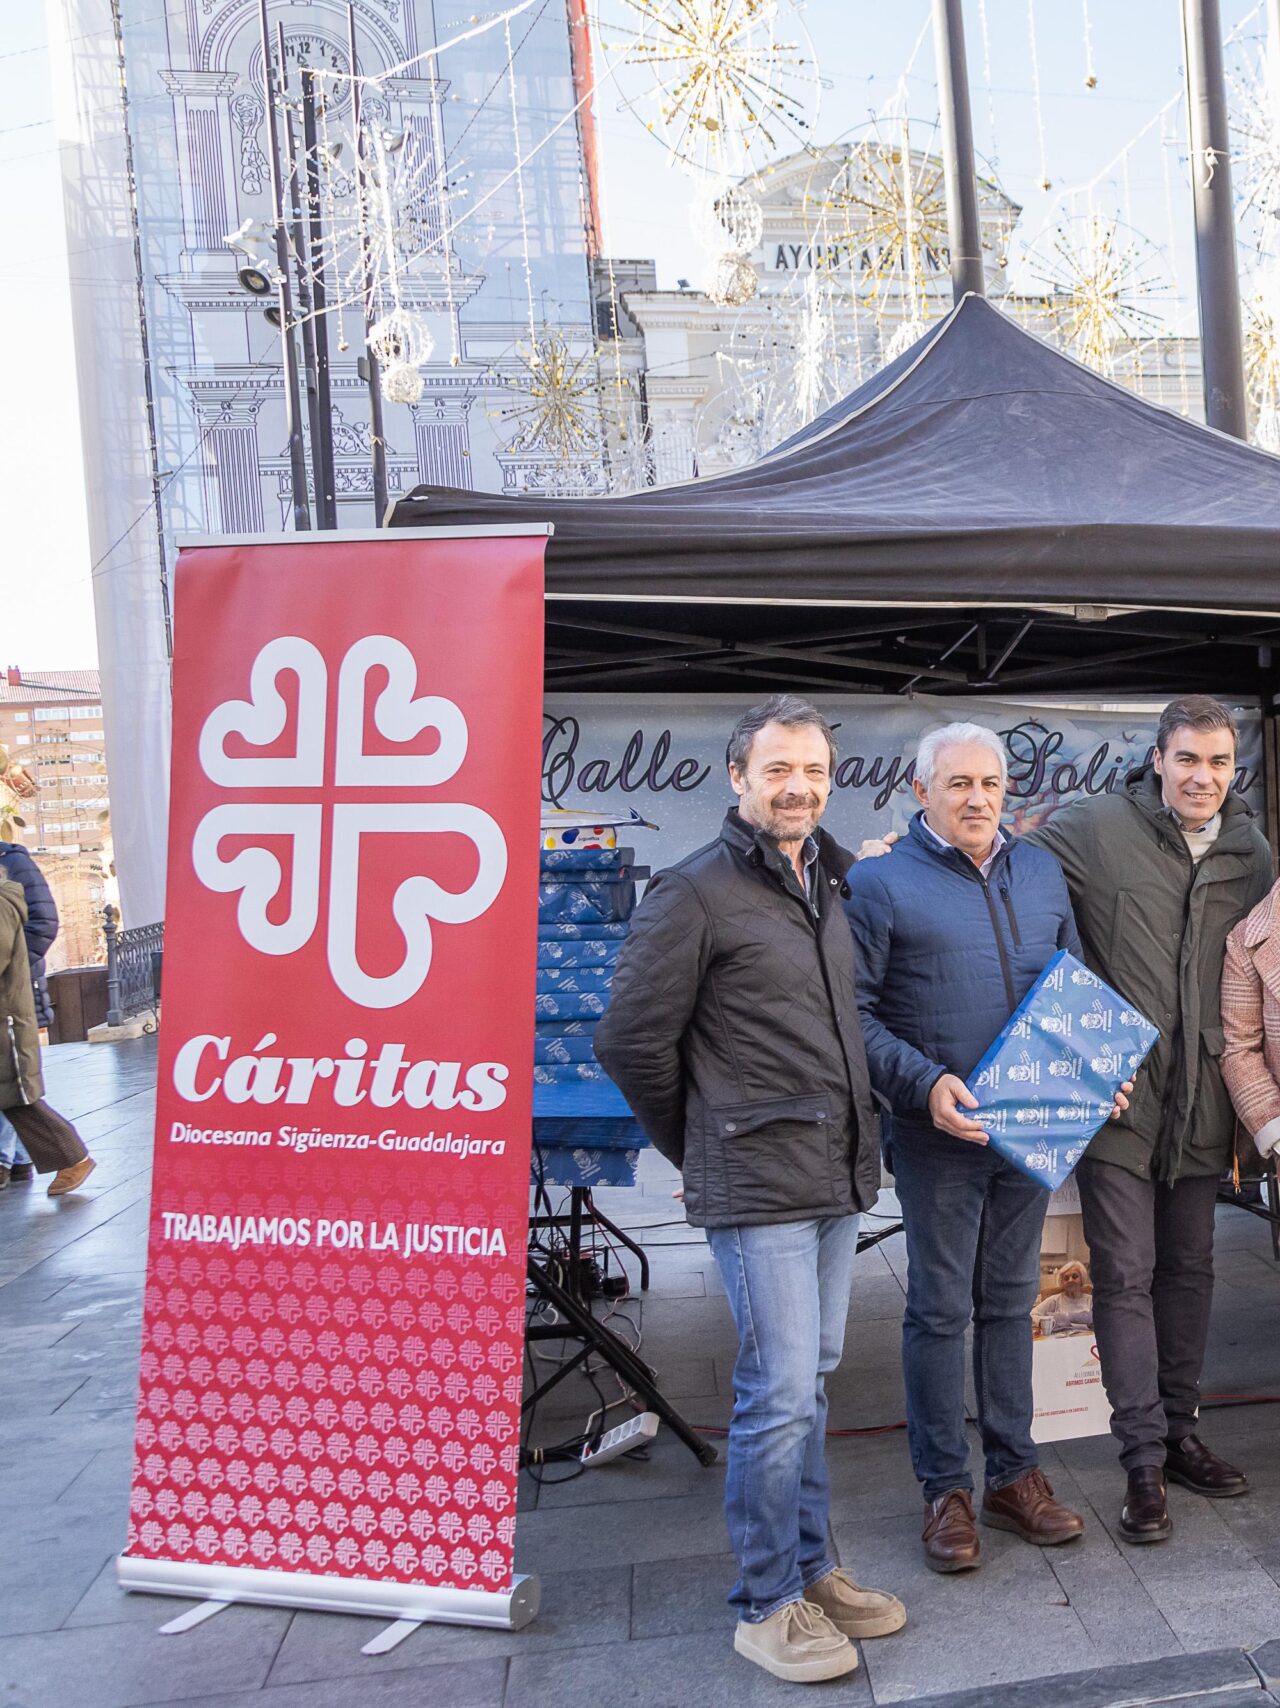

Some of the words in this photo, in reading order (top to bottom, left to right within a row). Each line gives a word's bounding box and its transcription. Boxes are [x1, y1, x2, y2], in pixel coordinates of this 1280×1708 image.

[298, 41, 311, 54] 12
[331, 56, 338, 68] 2
[173, 1032, 510, 1112] Cáritas
[169, 1121, 273, 1147] Diocesana
[277, 1125, 506, 1160] Sigüenza-Guadalajara
[161, 1212, 311, 1250] TRABAJAMOS
[316, 1218, 364, 1250] POR
[370, 1222, 400, 1252] LA
[403, 1223, 507, 1258] JUSTICIA
